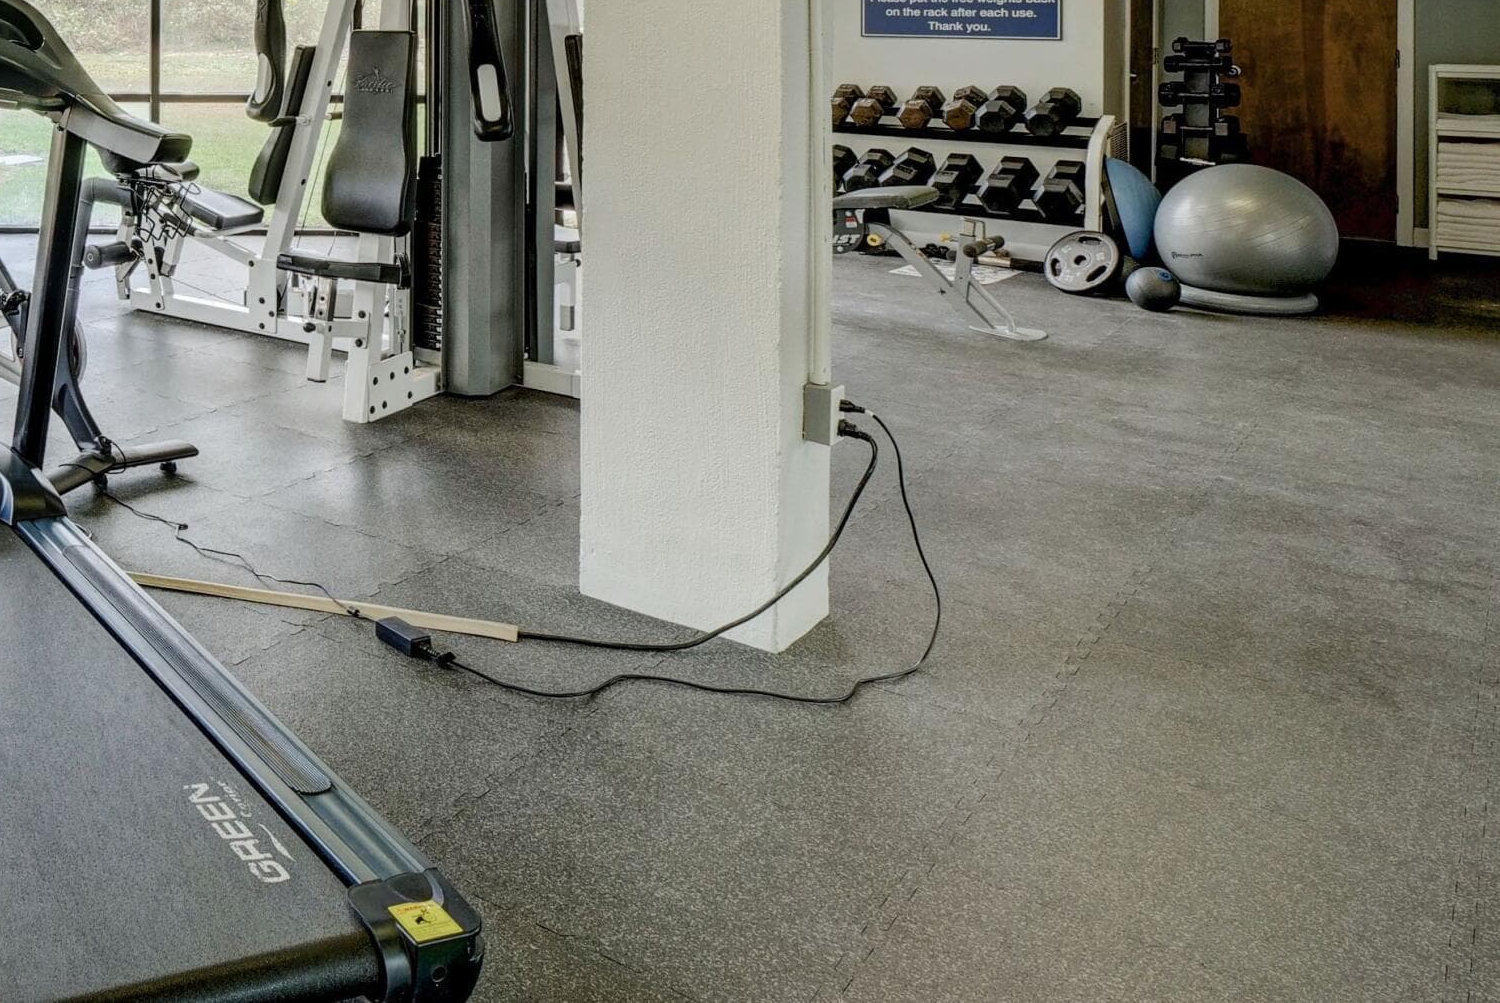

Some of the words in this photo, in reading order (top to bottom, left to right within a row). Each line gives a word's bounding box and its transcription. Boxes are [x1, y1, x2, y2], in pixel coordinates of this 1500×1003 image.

[885, 9, 900, 18] on
[902, 8, 921, 18] the
[923, 8, 948, 18] rack
[950, 8, 977, 18] after
[979, 8, 1009, 18] each
[1011, 9, 1037, 18] use.
[928, 21, 964, 32] Thank
[965, 23, 991, 34] you.
[187, 782, 291, 884] GREEN
